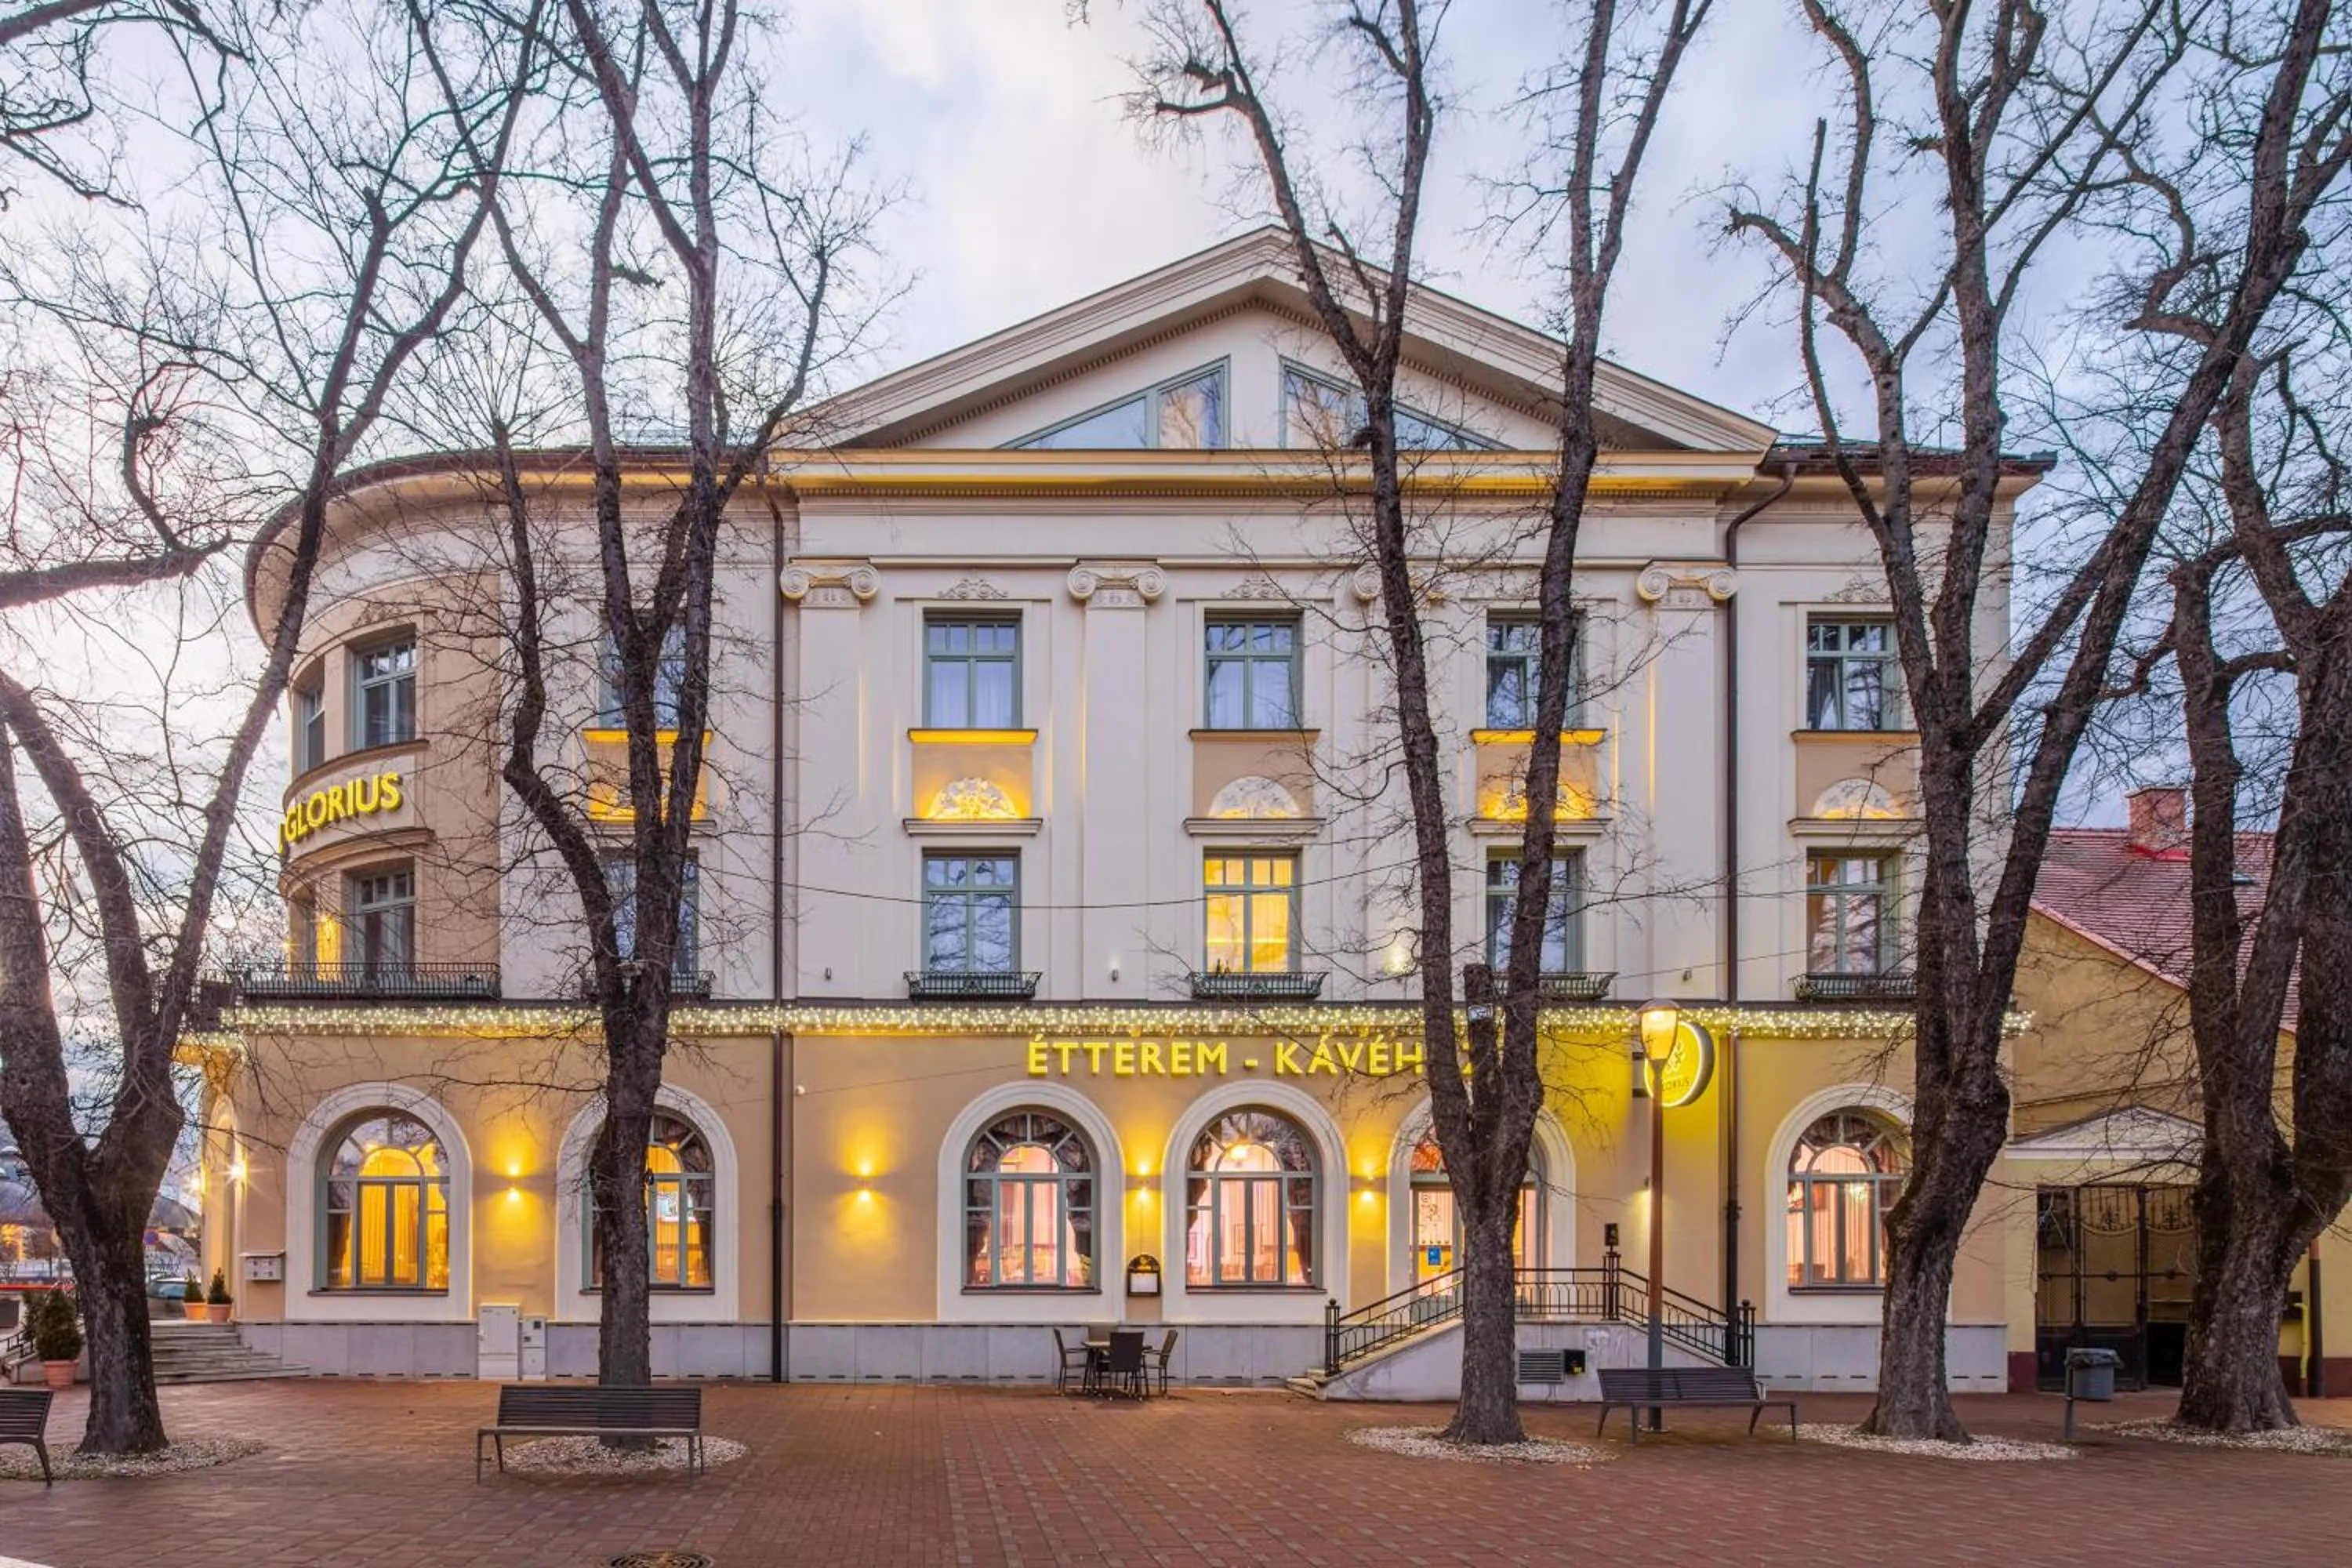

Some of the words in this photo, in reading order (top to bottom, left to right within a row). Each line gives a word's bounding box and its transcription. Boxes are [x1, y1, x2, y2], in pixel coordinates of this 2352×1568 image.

[285, 771, 403, 841] GLORIUS
[1028, 1033, 1228, 1076] ÉTTEREM
[1275, 1034, 1475, 1076] KÁVÉH
